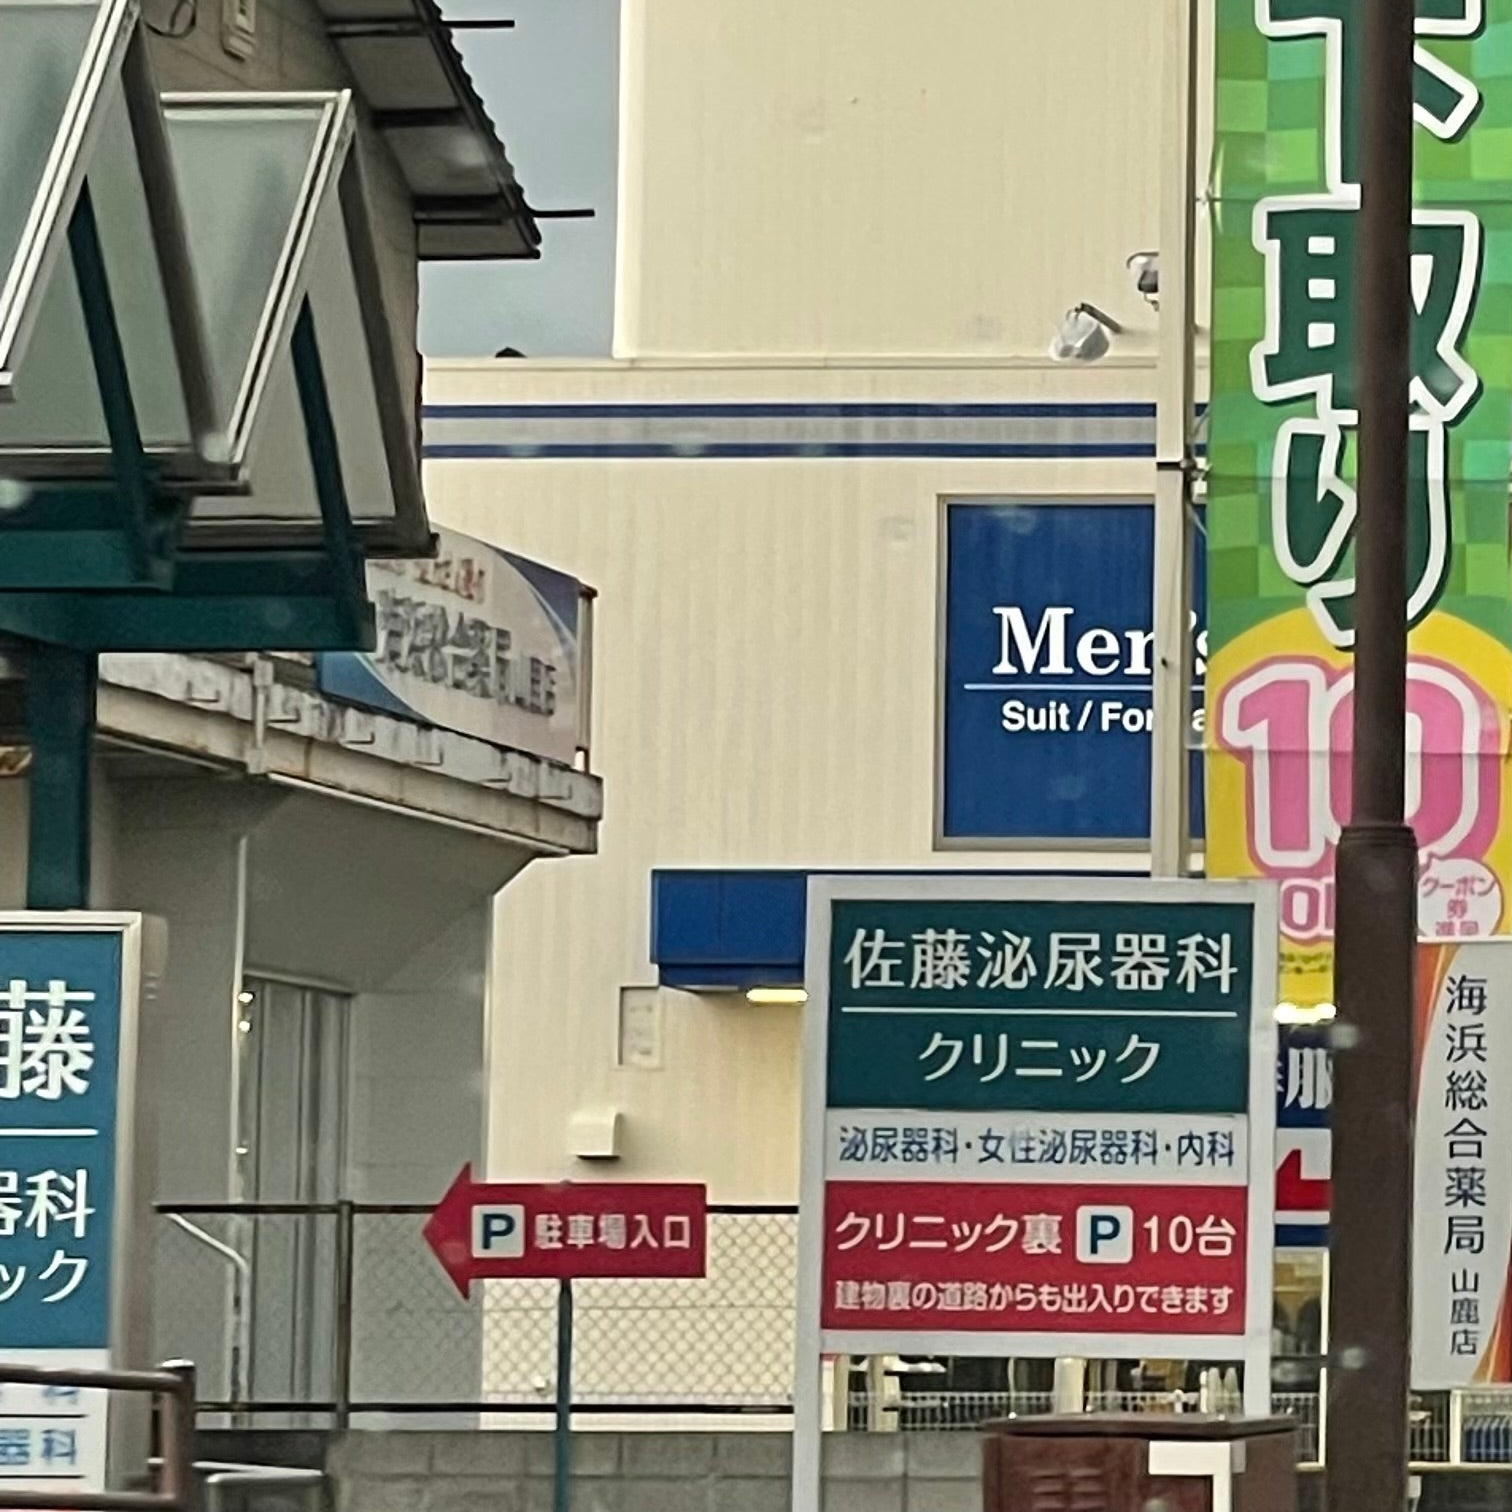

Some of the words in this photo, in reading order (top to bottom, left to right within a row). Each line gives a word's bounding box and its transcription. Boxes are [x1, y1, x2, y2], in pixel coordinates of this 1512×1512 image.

[1002, 701, 1071, 733] Suit
[843, 928, 1239, 994] 佐藤泌尿器科
[917, 1032, 1161, 1085] クリニック
[1444, 974, 1488, 1256] 海浜総合薬局
[481, 1212, 515, 1250] P
[534, 1212, 692, 1252] 駐車場入口
[835, 1211, 1064, 1256] クリニック裏
[1090, 1214, 1122, 1255] P
[1143, 1215, 1237, 1257] 10台
[1449, 1268, 1480, 1357] 山鹿店
